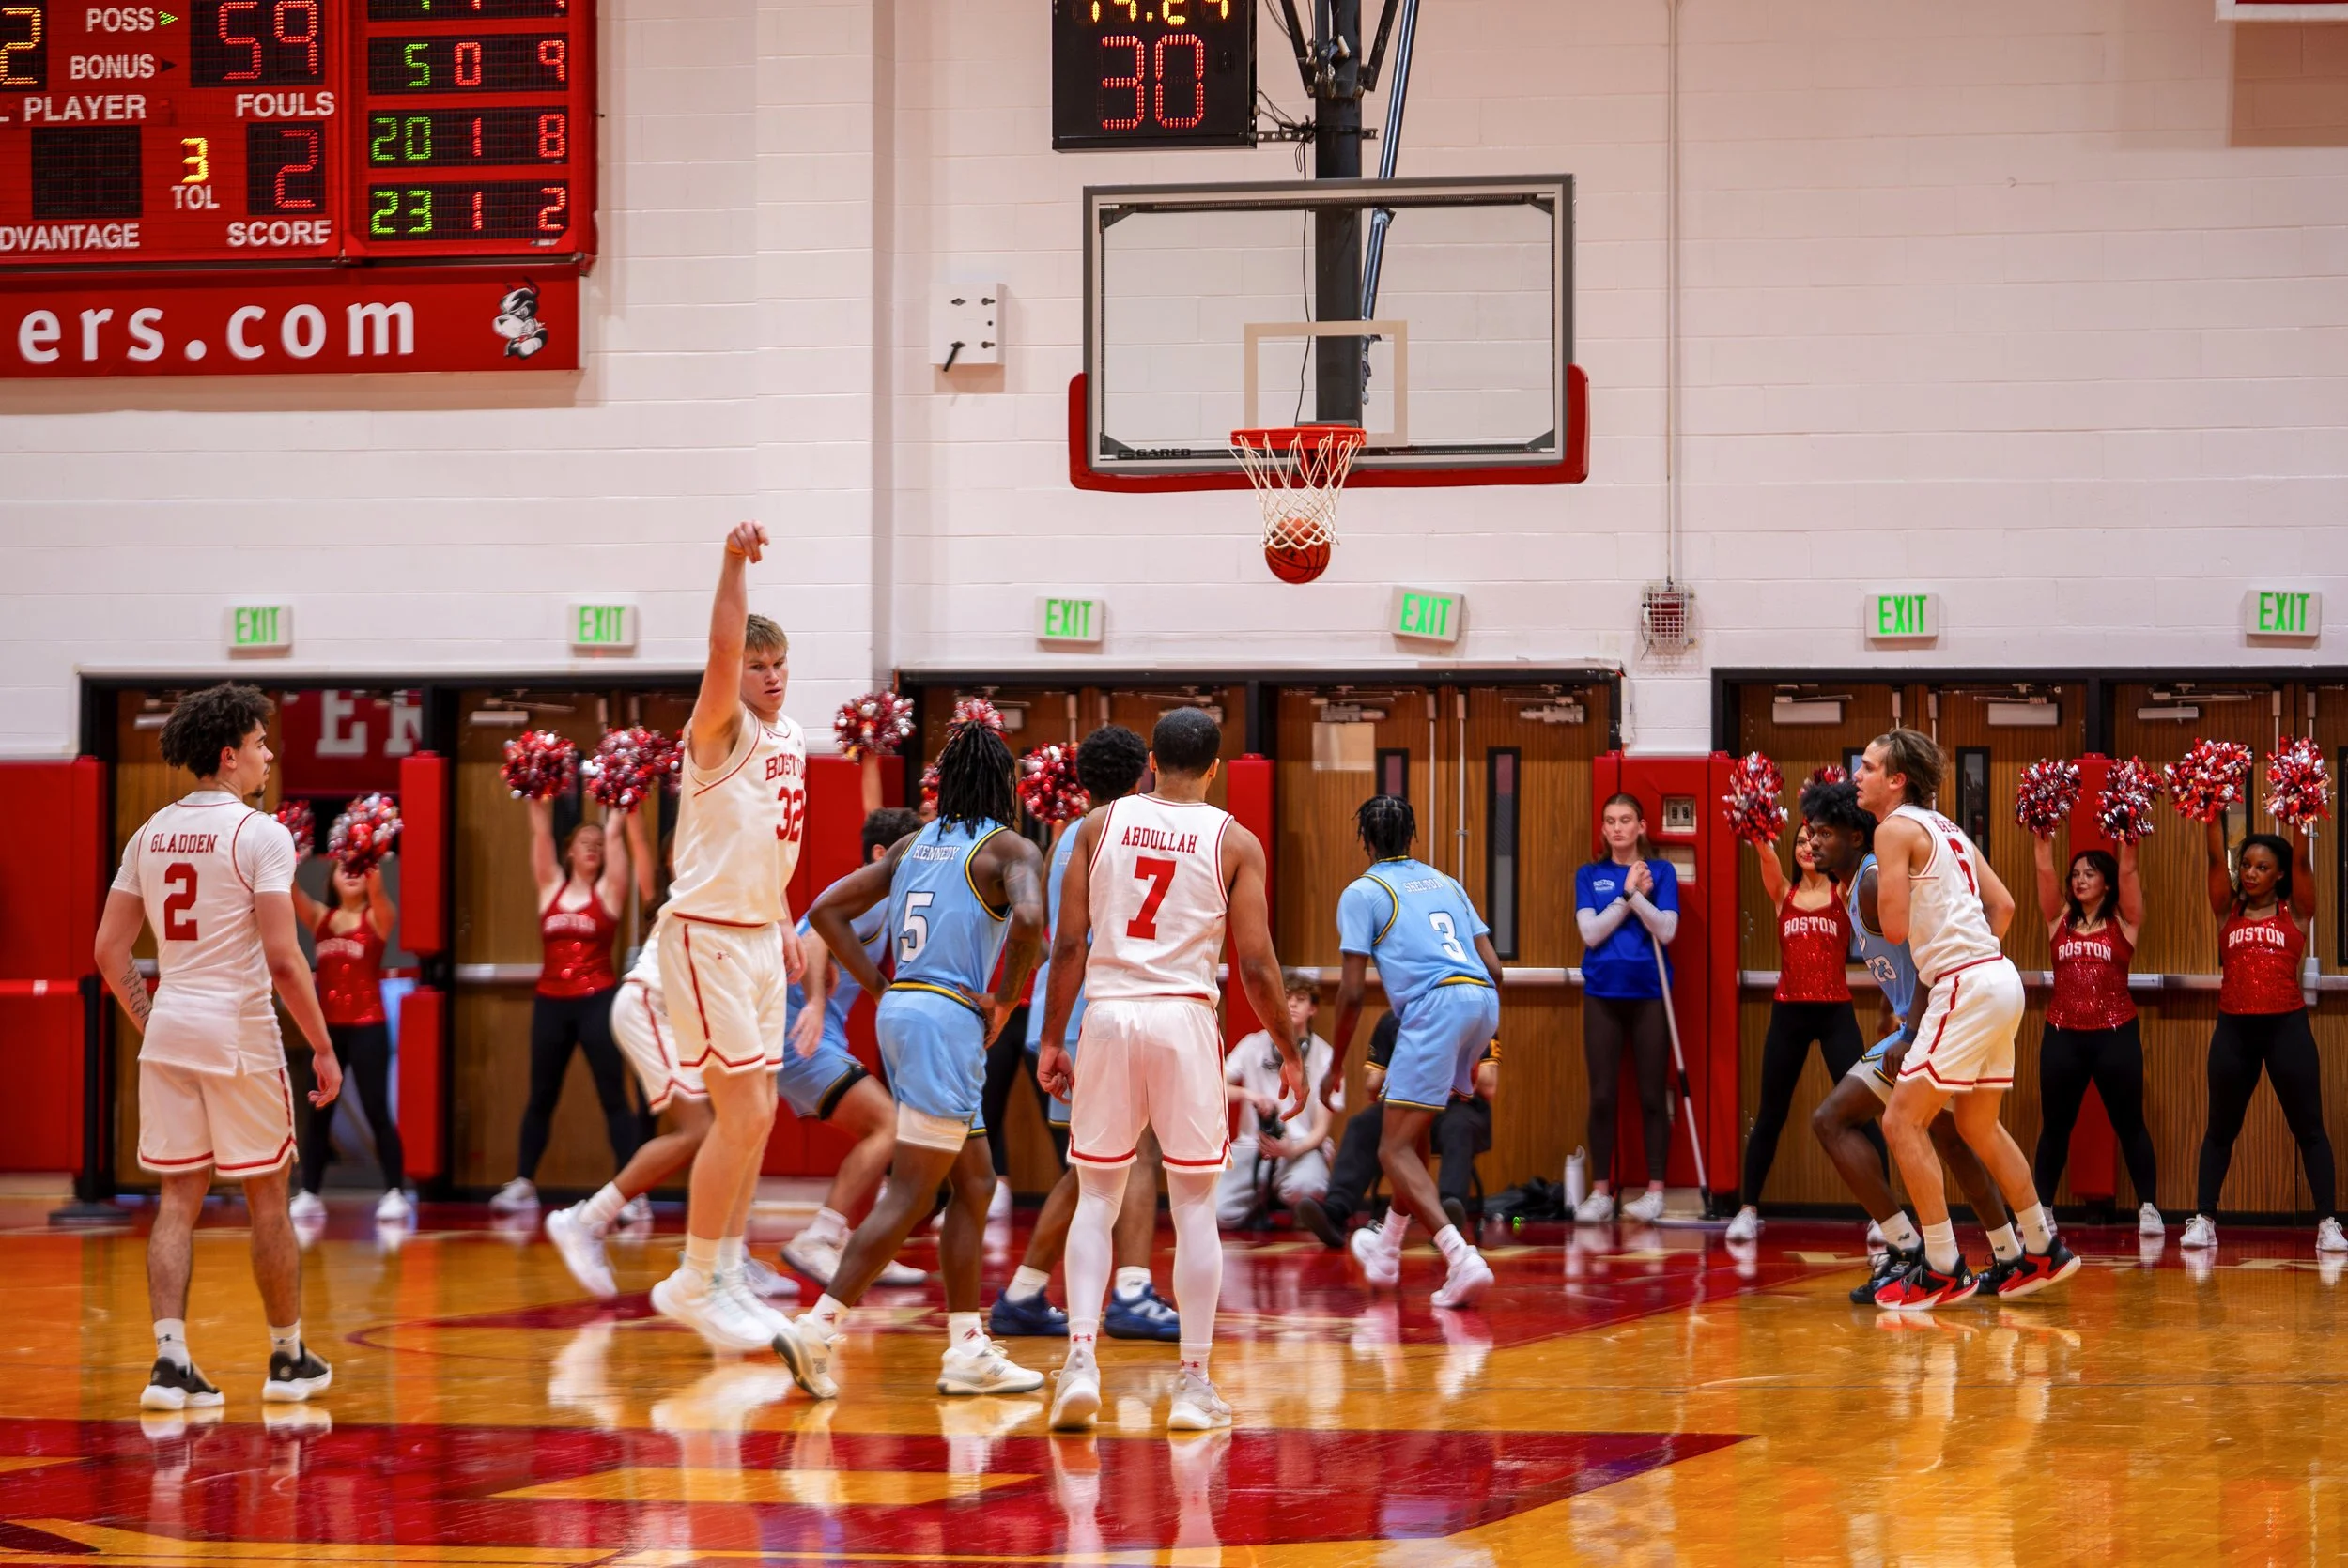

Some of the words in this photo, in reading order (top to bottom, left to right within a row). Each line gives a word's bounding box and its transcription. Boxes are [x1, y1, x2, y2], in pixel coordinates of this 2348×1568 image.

[85, 7, 155, 33] POSS
[219, 0, 318, 80] 59
[70, 54, 155, 80] BONUS
[403, 43, 431, 87] 5
[454, 41, 482, 86] 0
[538, 39, 565, 82] 9
[1102, 34, 1204, 130] 30
[23, 94, 147, 122] PLAYER
[236, 91, 335, 118] FOULS
[371, 116, 432, 161] 20
[472, 117, 483, 158] 1
[538, 113, 566, 158] 8
[181, 137, 209, 183] 3
[275, 130, 318, 208] 2
[170, 184, 220, 210] TOL
[371, 190, 433, 234] 23
[472, 191, 484, 231] 1
[538, 187, 567, 232] 2
[226, 219, 332, 247] SCORE
[17, 300, 414, 364] ers.com
[235, 606, 281, 644] EXIT
[578, 605, 626, 643] EXIT
[1044, 598, 1094, 638] EXIT
[1399, 592, 1452, 636] EXIT
[1878, 594, 1928, 636] EXIT
[2259, 592, 2310, 633] EXIT
[776, 786, 806, 843] 32
[150, 833, 218, 853] GLADDEN
[912, 844, 961, 861] KENNEDY
[1121, 825, 1198, 853] ABDULLAH
[163, 862, 198, 941] 2
[1126, 855, 1177, 940] 7
[1403, 878, 1444, 893] SHELTON
[899, 890, 935, 963] 5
[1428, 910, 1469, 962] 3
[1784, 916, 1837, 937] BOSTON
[2229, 926, 2285, 948] BOSTON
[2058, 940, 2112, 961] BOSTON
